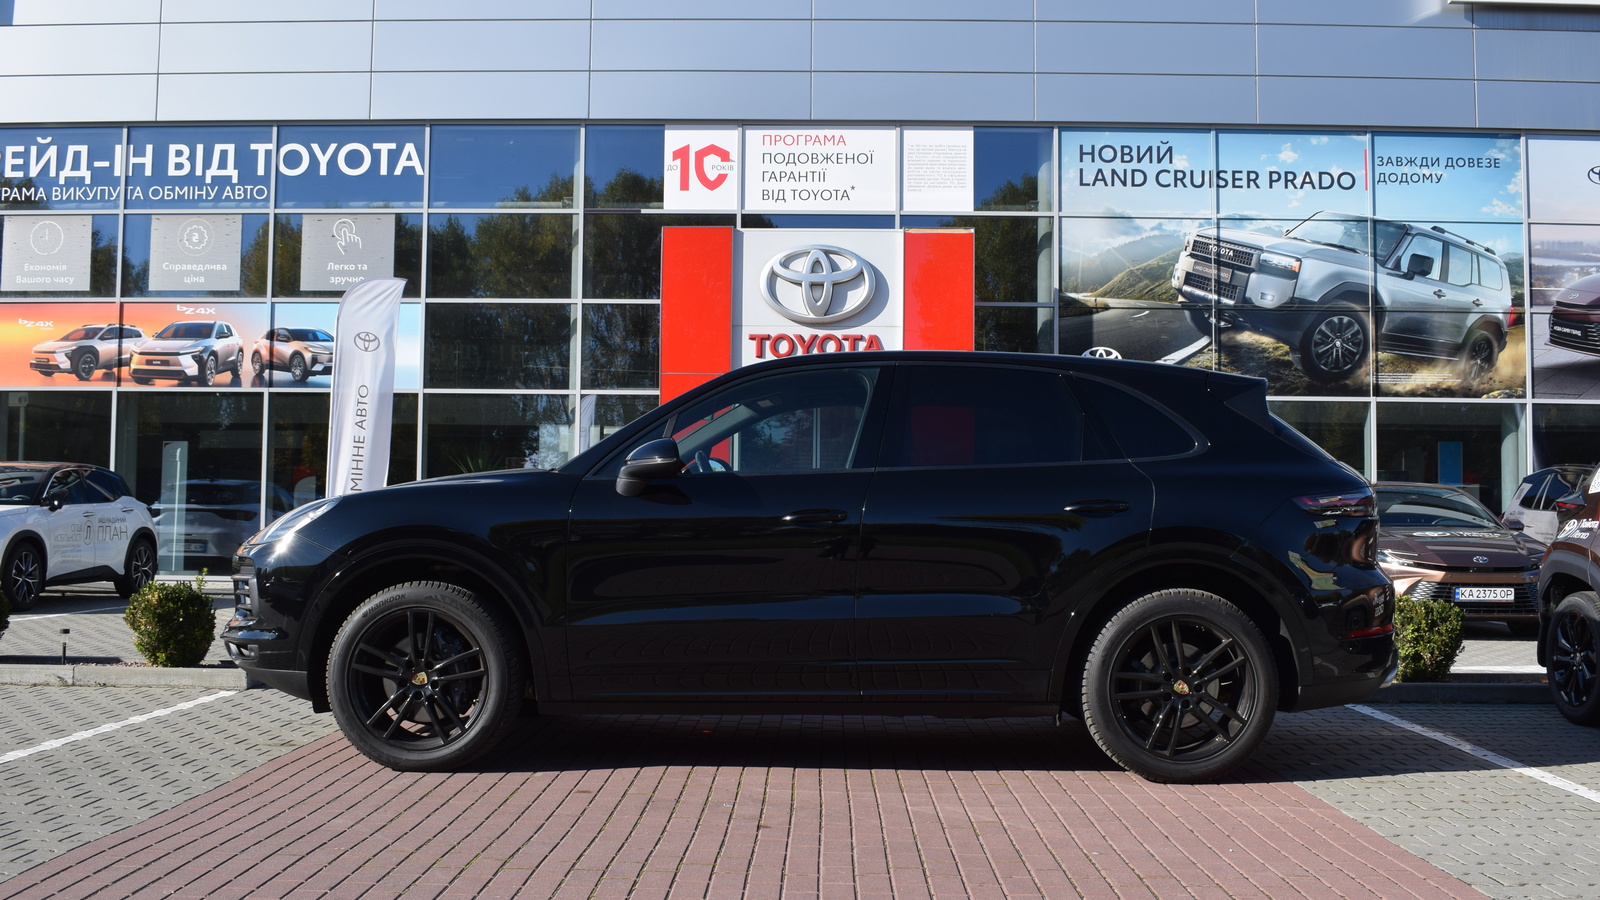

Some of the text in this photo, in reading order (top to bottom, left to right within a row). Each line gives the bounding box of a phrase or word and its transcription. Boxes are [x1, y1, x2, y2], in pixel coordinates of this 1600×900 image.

[762, 134, 847, 147] ПРОГРАМА
[762, 150, 875, 167] ПОДОВЖЕНОЇ
[1079, 140, 1173, 165] НОВИЙ
[0, 136, 424, 185] ЕЙД-ІН ВІД TOYOTA
[1376, 156, 1501, 170] ЗАВЖДИ ДОВЕЗЕ
[666, 164, 678, 172] ДО
[711, 164, 734, 172] РОКІВ
[762, 168, 828, 183] ГАРАНТІЇ
[1079, 168, 1356, 191] LAND CRUISER PRADO
[1376, 172, 1444, 185] ДОДОМУ
[0, 185, 268, 201] РАМА ВИКУПУ ТА ОБМІНУ АВТО
[761, 189, 787, 204] ВІД
[24, 263, 67, 272] Економія
[162, 262, 228, 273] Справедлива
[327, 262, 368, 271] Легко та
[15, 275, 75, 285] Вашого часу
[184, 275, 205, 284] ціна
[748, 333, 883, 359] TOYOTA
[355, 384, 369, 430] АВТО
[97, 525, 129, 541] ПЛАН
[1460, 589, 1514, 599] KA 2375 OP
